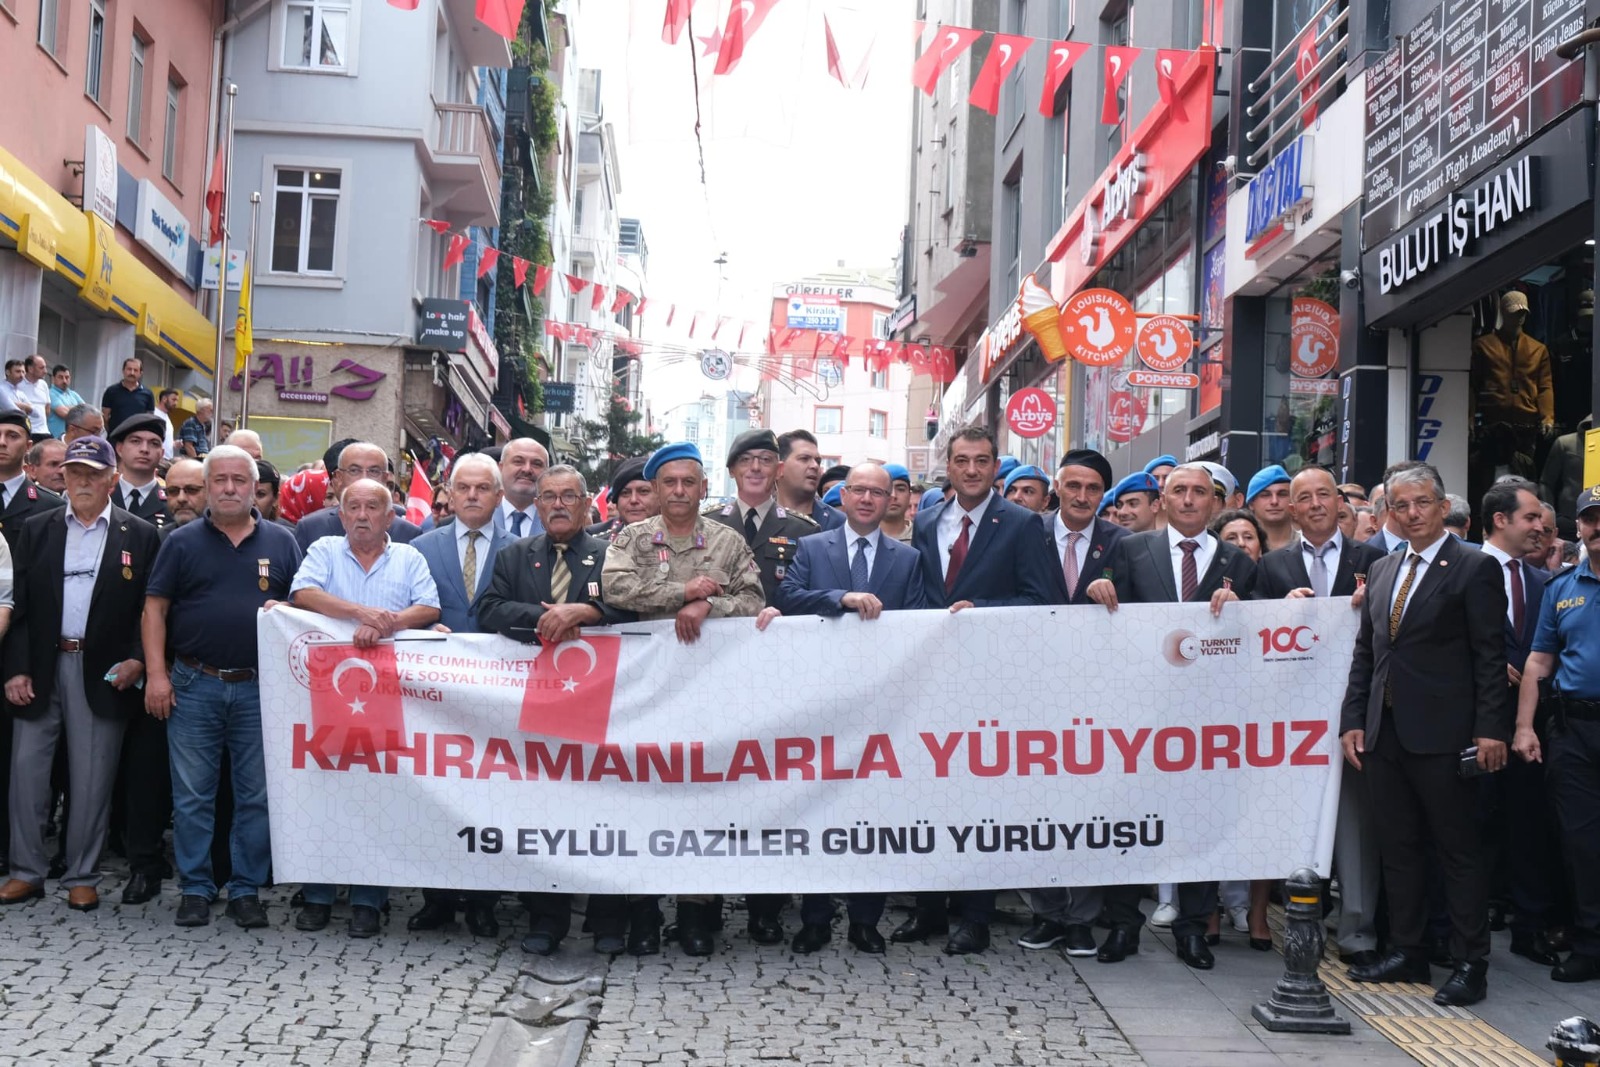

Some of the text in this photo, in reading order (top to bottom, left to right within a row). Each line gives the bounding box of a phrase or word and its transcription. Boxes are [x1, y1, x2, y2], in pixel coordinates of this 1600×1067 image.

[1500, 18, 1518, 41] Mutlu
[1534, 16, 1584, 62] Dijital Jeans
[1491, 25, 1526, 64] Dekorasyon
[1411, 50, 1435, 78] Snatch
[1411, 69, 1433, 93] Tattoo
[1491, 72, 1523, 109] Yemekleri
[1412, 136, 1428, 157] Cadde
[1408, 145, 1433, 174] Hediyelik
[1413, 123, 1512, 207] Bozkurt Fight Academy
[1101, 142, 1140, 231] Arby's
[1373, 167, 1389, 187] Cadde
[1369, 176, 1394, 203] Hediyelik
[1379, 155, 1531, 295] BULUT İŞ HANI
[448, 312, 466, 321] hair
[1072, 294, 1126, 316] LOUISIANA
[425, 328, 464, 339] make up
[1145, 318, 1185, 334] LOUISIANA
[1075, 345, 1124, 361] KITCHEN
[1147, 356, 1183, 368] KITCHEN
[330, 359, 387, 400] Z
[280, 392, 327, 401] accessorise
[1011, 409, 1052, 424] Arby's
[429, 655, 538, 673] CUMHURİYETİ
[418, 670, 479, 685] SOSYAL
[360, 681, 442, 702] BAKANLIĞI
[292, 717, 1330, 783] KAHRAMANLARLA YÜRÜYORUZ
[456, 814, 1164, 858] 19 EYLÜL GAZİLER GÜNÜ YÜRÜYÜŞÜ
